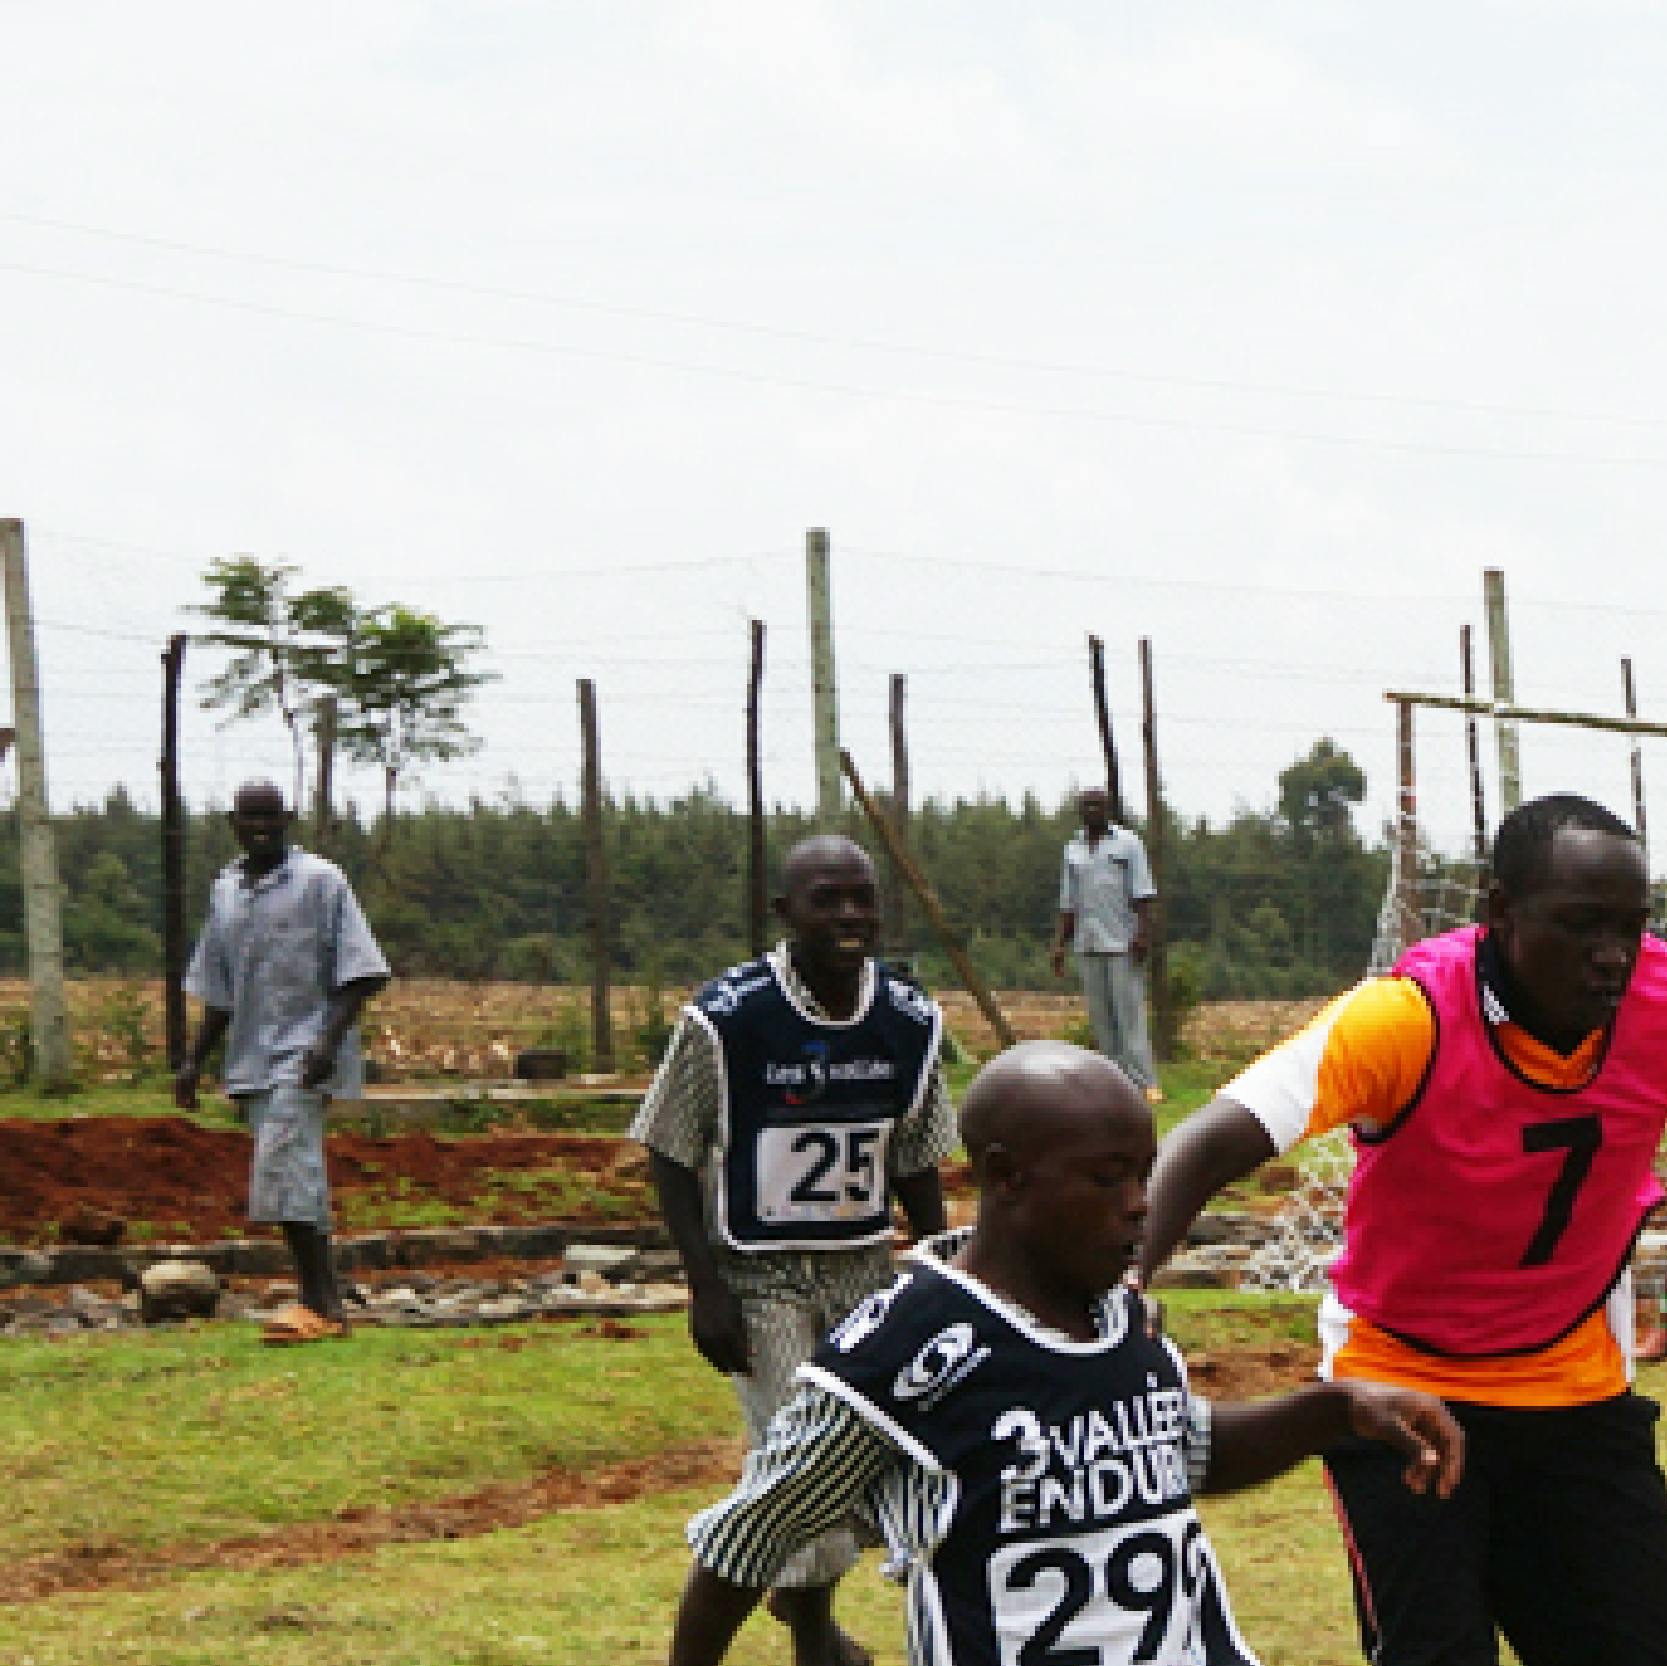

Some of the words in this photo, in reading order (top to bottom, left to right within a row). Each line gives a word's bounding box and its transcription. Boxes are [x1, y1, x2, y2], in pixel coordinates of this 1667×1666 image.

[790, 1130, 880, 1202] 25
[1521, 1114, 1602, 1268] 7
[990, 1407, 1051, 1481] 3
[1049, 1371, 1188, 1468] VALLÉE
[997, 1443, 1190, 1534] ENDUR
